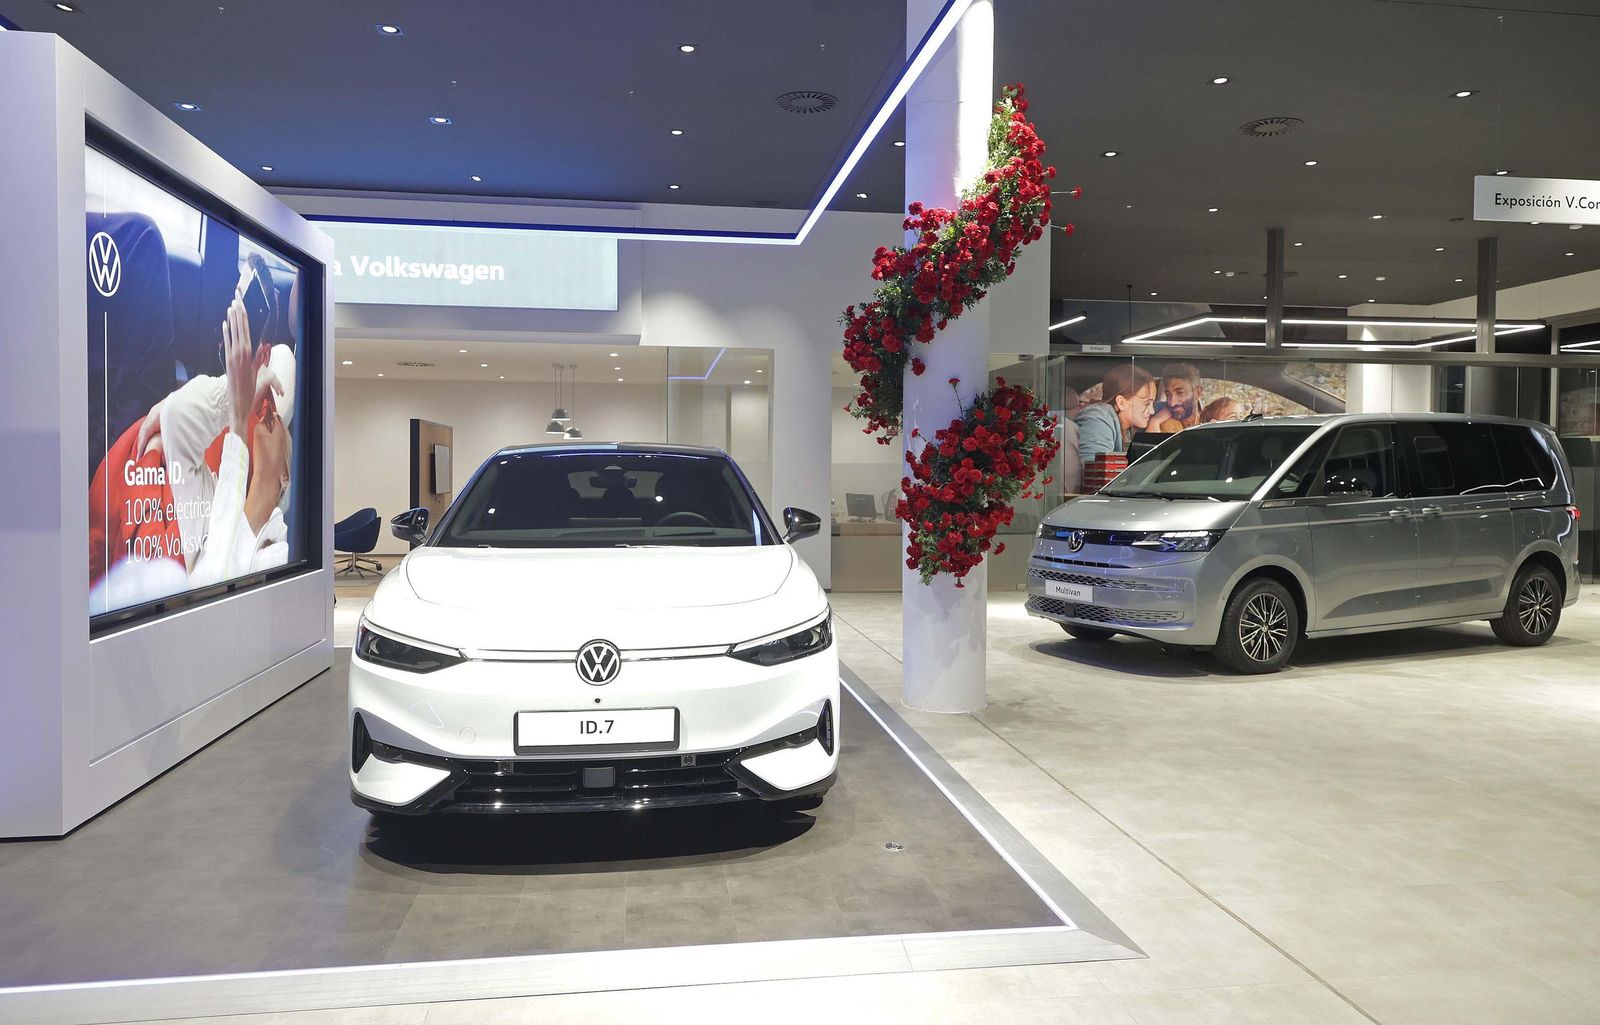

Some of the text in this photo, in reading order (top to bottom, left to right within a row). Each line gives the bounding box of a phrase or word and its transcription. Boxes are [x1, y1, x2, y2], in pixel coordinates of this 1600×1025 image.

[1494, 192, 1561, 209] Exposición
[350, 255, 505, 286] Volkswagen
[124, 459, 185, 486] Gama ID.
[125, 497, 163, 526] 100%
[125, 534, 163, 565] 100%
[1055, 586, 1081, 597] Multivan
[580, 719, 615, 735] ID.7
